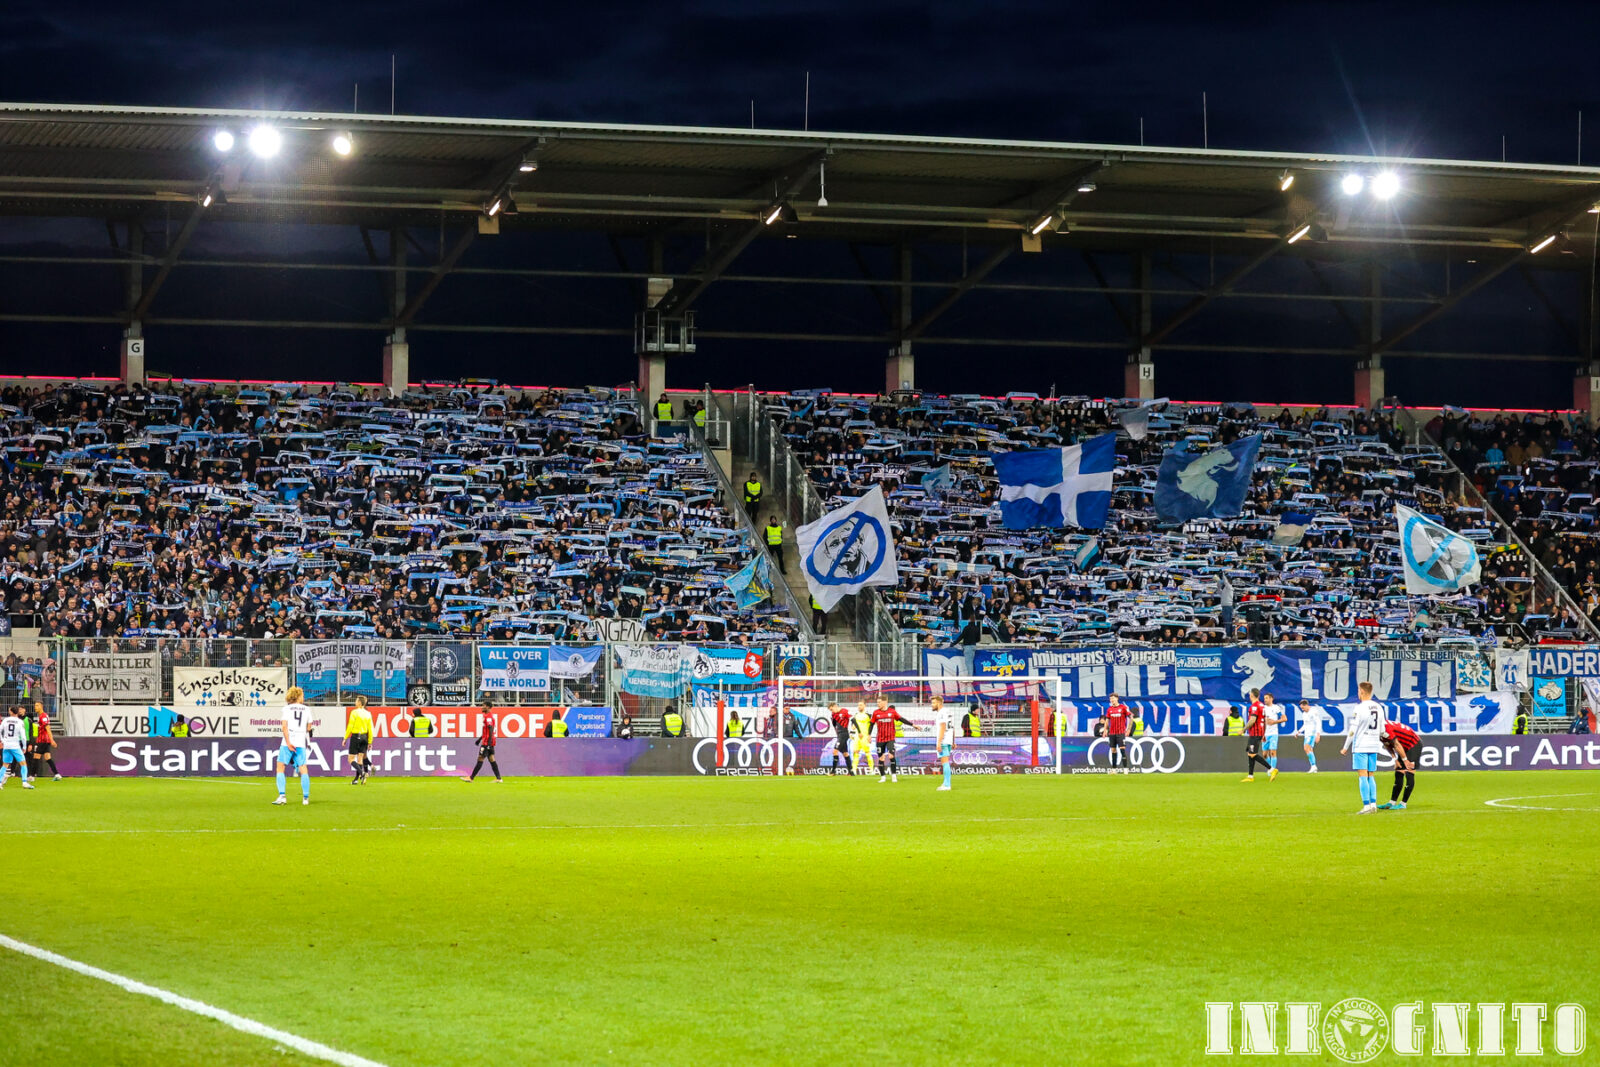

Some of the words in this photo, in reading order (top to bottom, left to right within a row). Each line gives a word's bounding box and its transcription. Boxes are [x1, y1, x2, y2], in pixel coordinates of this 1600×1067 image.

[131, 342, 140, 353] G
[488, 650, 509, 660] ALL
[512, 650, 542, 660] OVER
[780, 645, 810, 657] MIB
[1032, 651, 1104, 666] MÜNCHENS
[1130, 650, 1175, 665] JUGEND
[72, 657, 152, 669] MARKTLER
[1528, 652, 1600, 675] HADER
[72, 675, 131, 691] LÖWEN
[177, 669, 285, 697] Engelsberger
[485, 678, 505, 687] THE
[508, 678, 546, 687] WORLD
[1298, 651, 1452, 701] LÖWEN
[294, 711, 303, 727] 4
[578, 713, 606, 722] Parsberg
[1368, 711, 1378, 729] 3
[8, 723, 15, 737] 9
[110, 741, 279, 771] Starker
